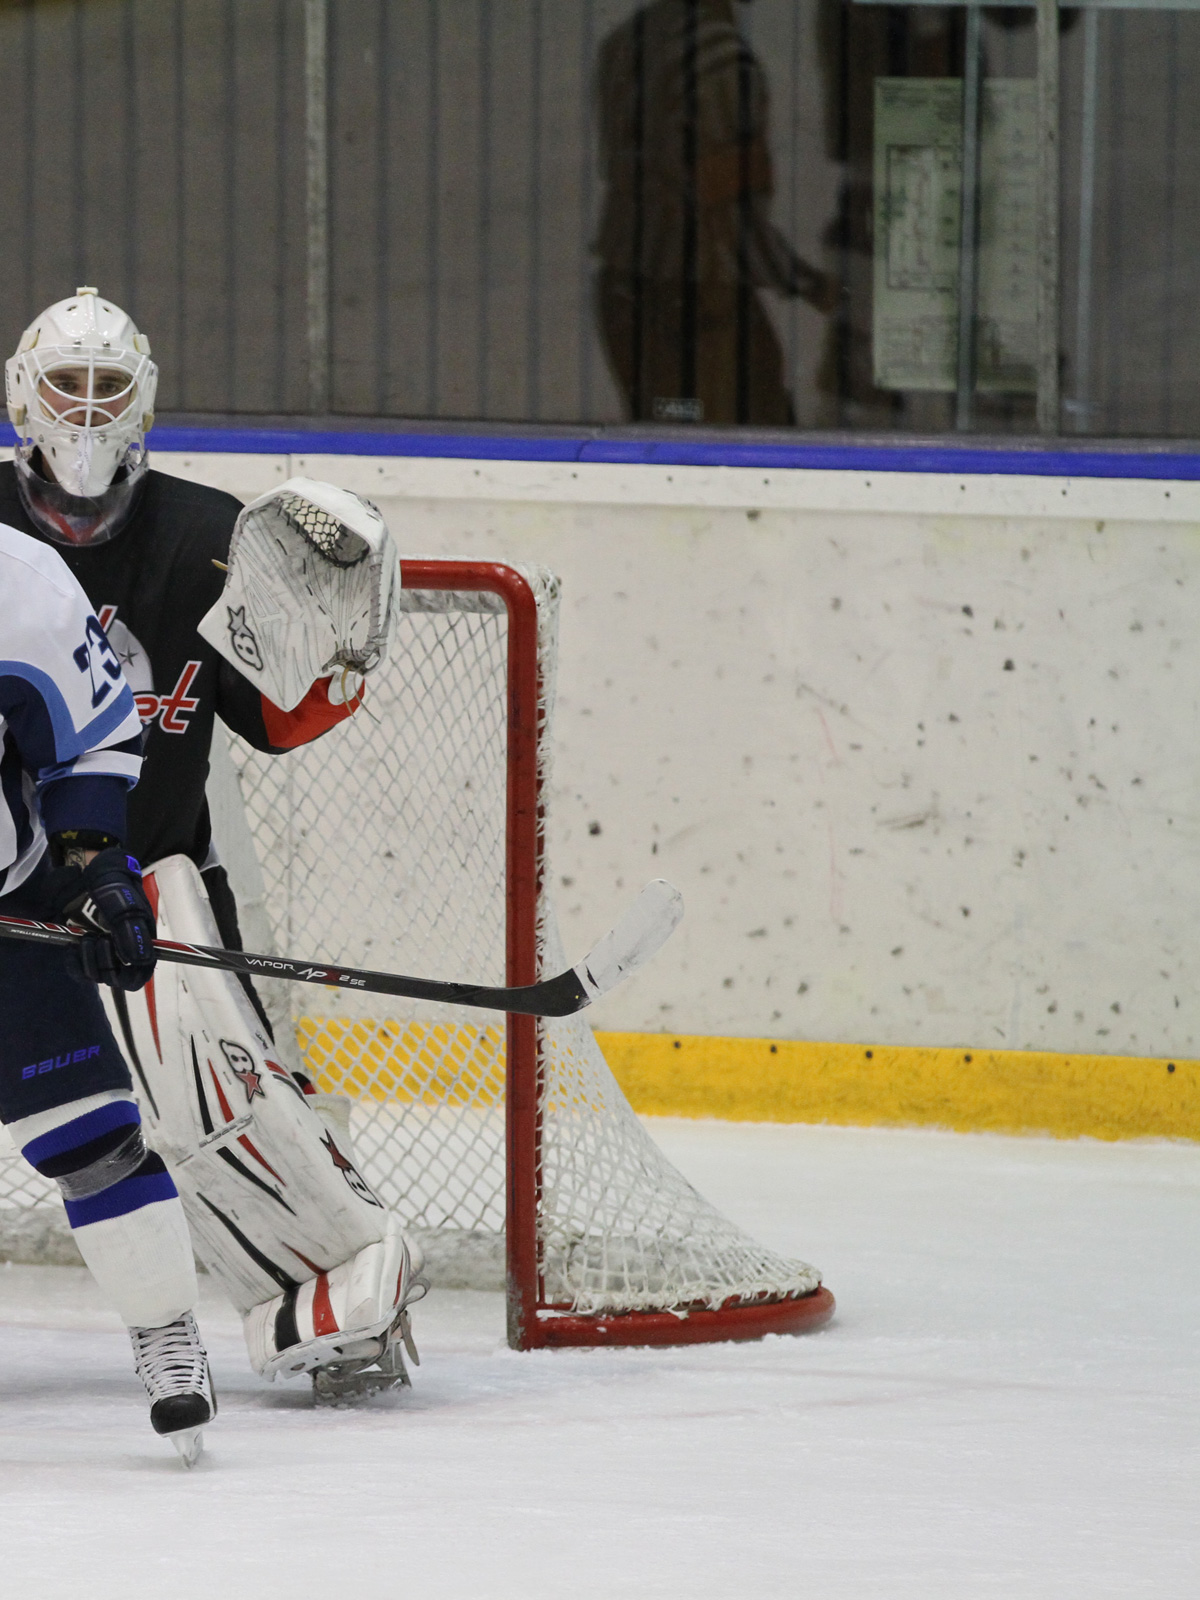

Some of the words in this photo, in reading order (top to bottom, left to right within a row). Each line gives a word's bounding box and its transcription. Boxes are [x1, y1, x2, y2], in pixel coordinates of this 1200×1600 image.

[73, 614, 122, 710] 23
[244, 956, 296, 972] VAPOR
[21, 1045, 101, 1081] BAUER
